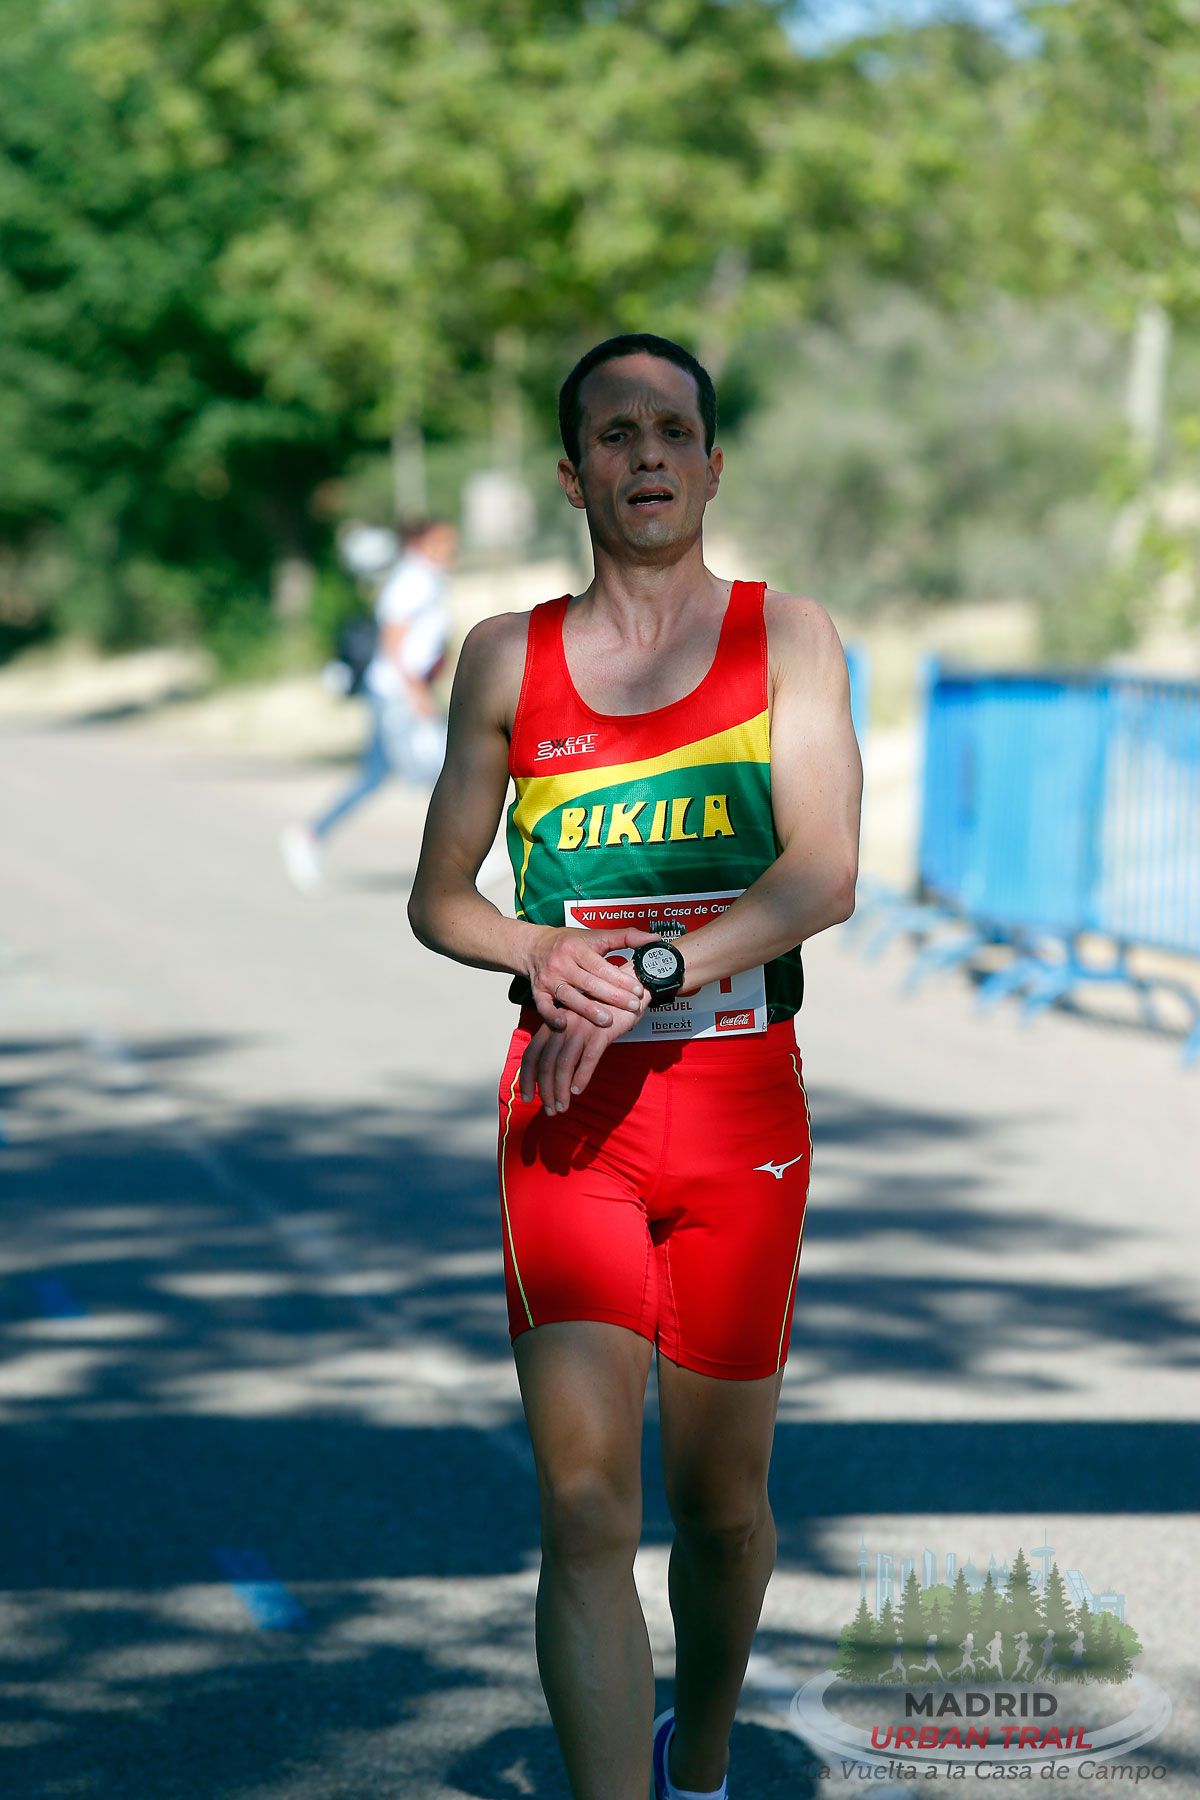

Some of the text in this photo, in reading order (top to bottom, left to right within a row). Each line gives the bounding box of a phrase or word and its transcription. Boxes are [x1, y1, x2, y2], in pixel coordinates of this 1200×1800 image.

[537, 733, 599, 750] SWEET
[534, 742, 596, 761] SMILE
[557, 794, 738, 852] BIKILA
[582, 911, 597, 921] XII
[599, 909, 635, 920] Vuelta
[647, 908, 658, 918] la
[663, 907, 692, 917] Casa
[694, 905, 708, 915] de
[652, 1019, 692, 1030] Iberext
